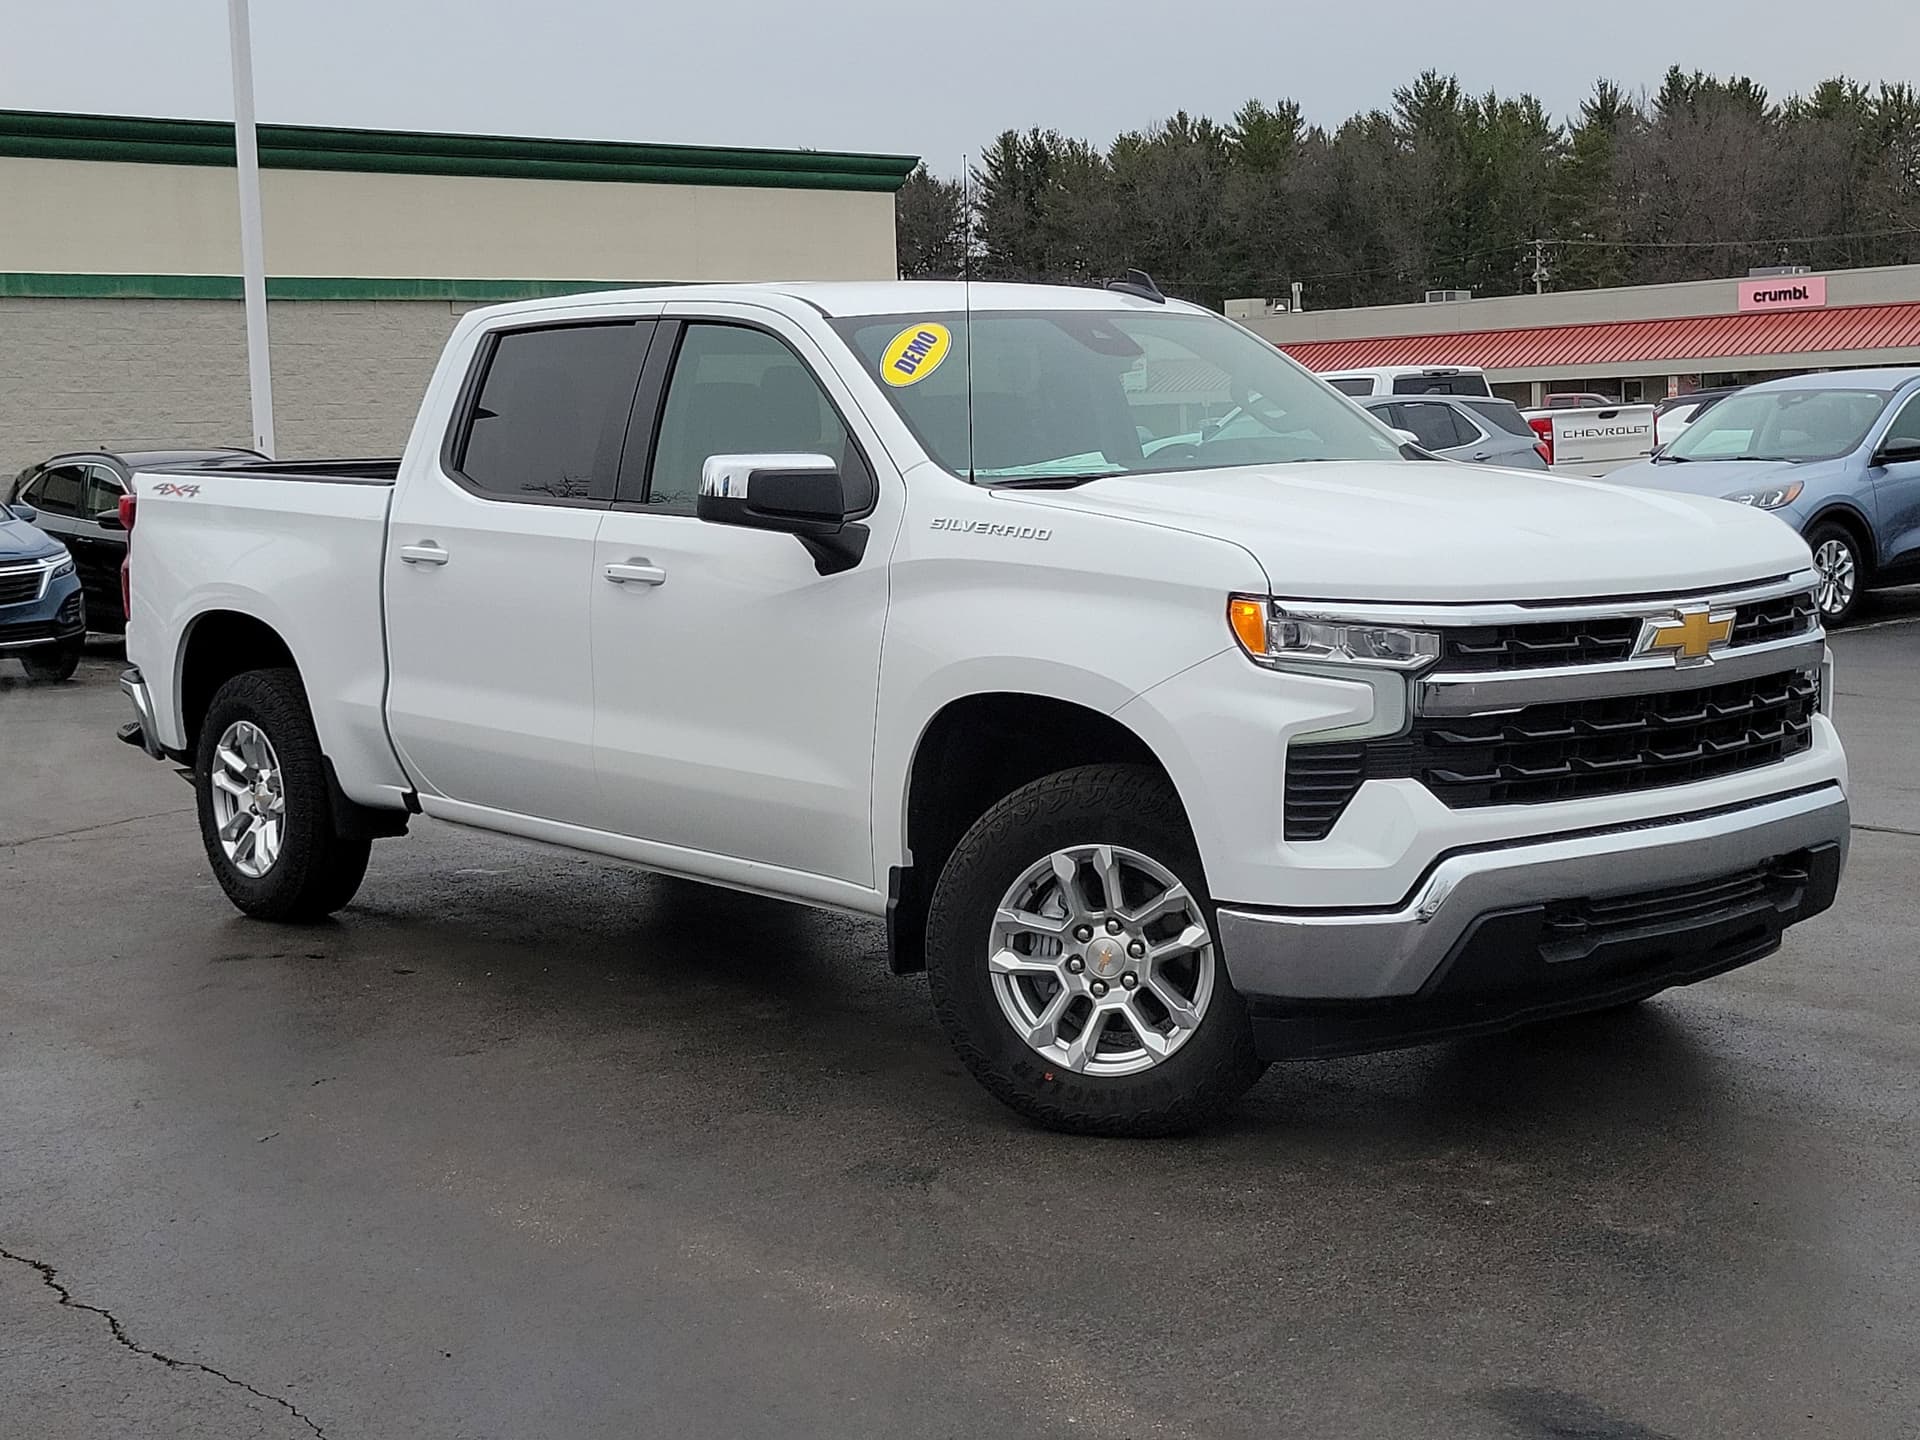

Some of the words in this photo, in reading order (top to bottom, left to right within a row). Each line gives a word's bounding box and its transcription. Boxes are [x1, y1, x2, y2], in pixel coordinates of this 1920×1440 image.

[1753, 285, 1809, 303] crumbl
[894, 331, 938, 375] DEMO
[1562, 425, 1650, 439] CHEVROLET
[929, 518, 1053, 541] SILVERADO
